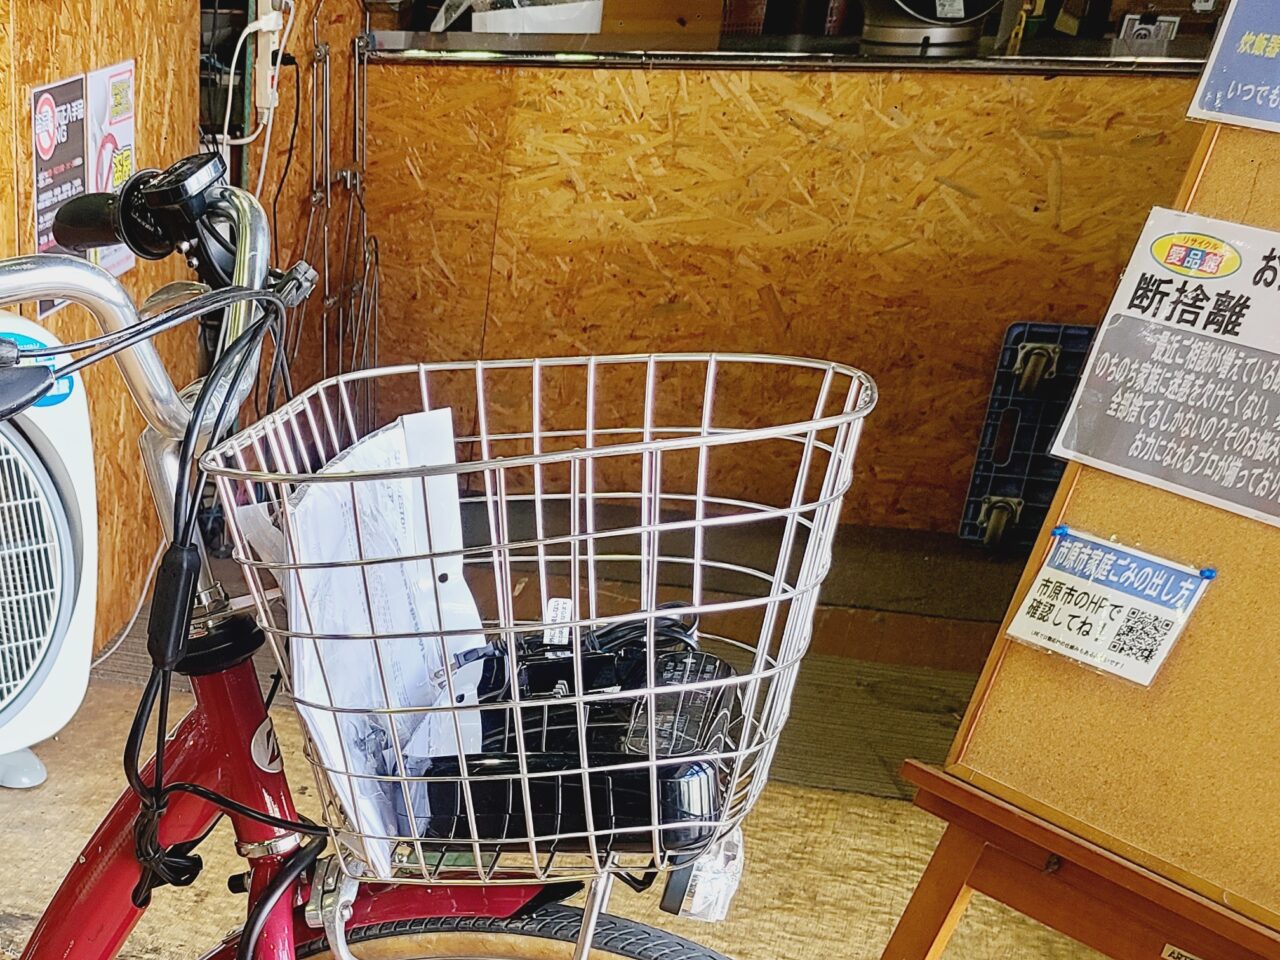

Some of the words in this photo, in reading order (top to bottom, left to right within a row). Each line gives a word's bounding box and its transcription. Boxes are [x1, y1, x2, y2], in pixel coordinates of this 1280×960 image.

[1183, 236, 1220, 251] リサイクル
[1127, 272, 1251, 337] 断捨離
[1054, 539, 1196, 607] 市原市家庭ごみの出し方
